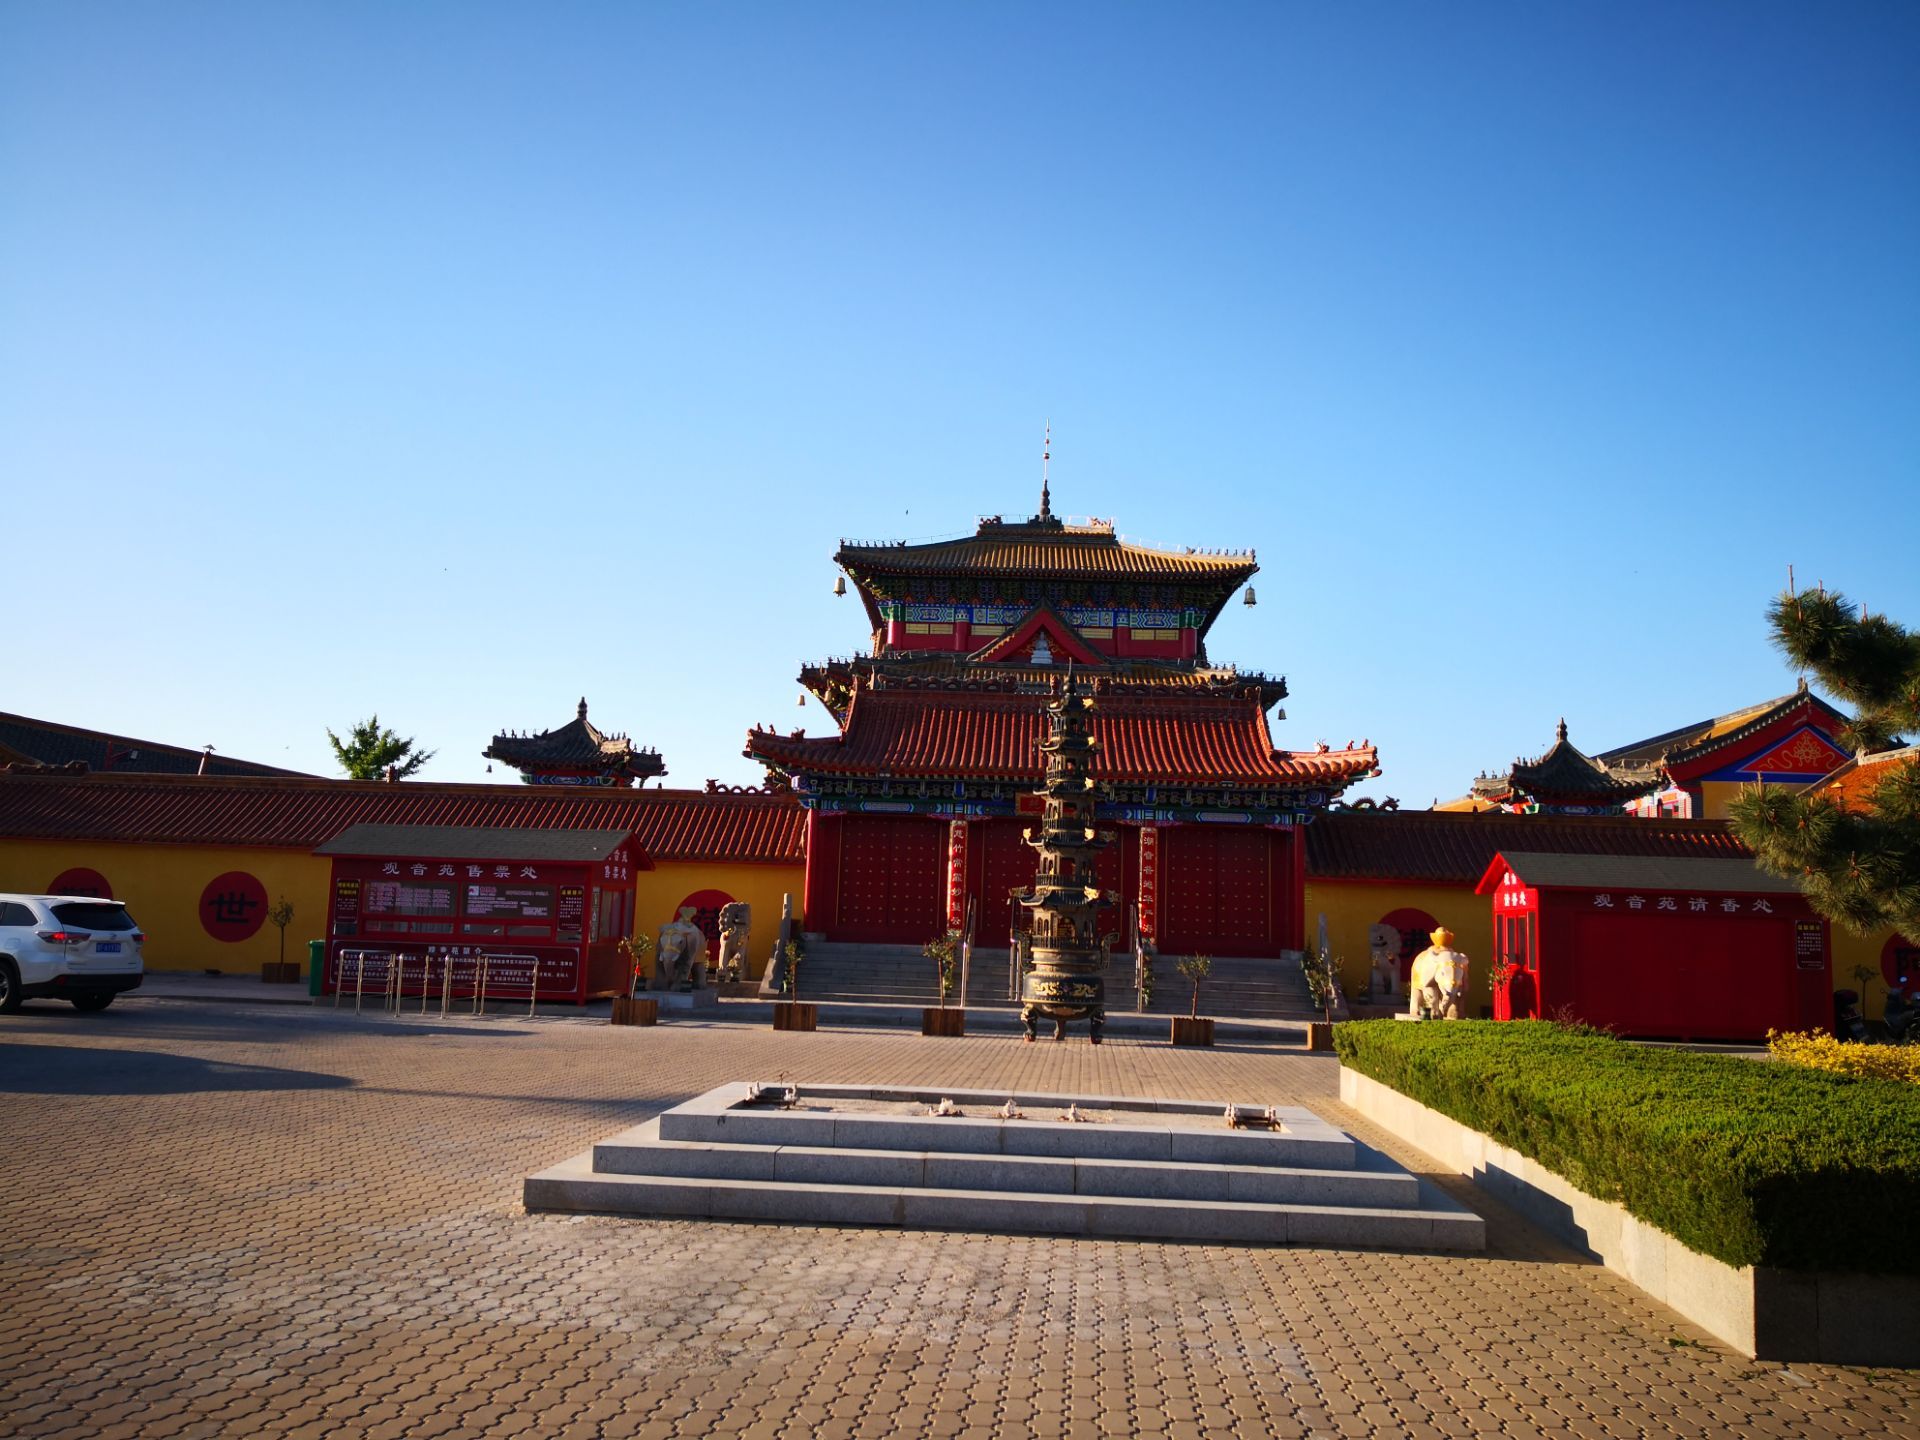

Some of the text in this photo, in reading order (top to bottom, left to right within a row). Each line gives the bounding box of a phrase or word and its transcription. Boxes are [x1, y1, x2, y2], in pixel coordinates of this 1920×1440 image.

[382, 861, 538, 880] 观音苑售票处
[207, 891, 259, 924] 世
[1593, 893, 1774, 914] 观音苑请香处
